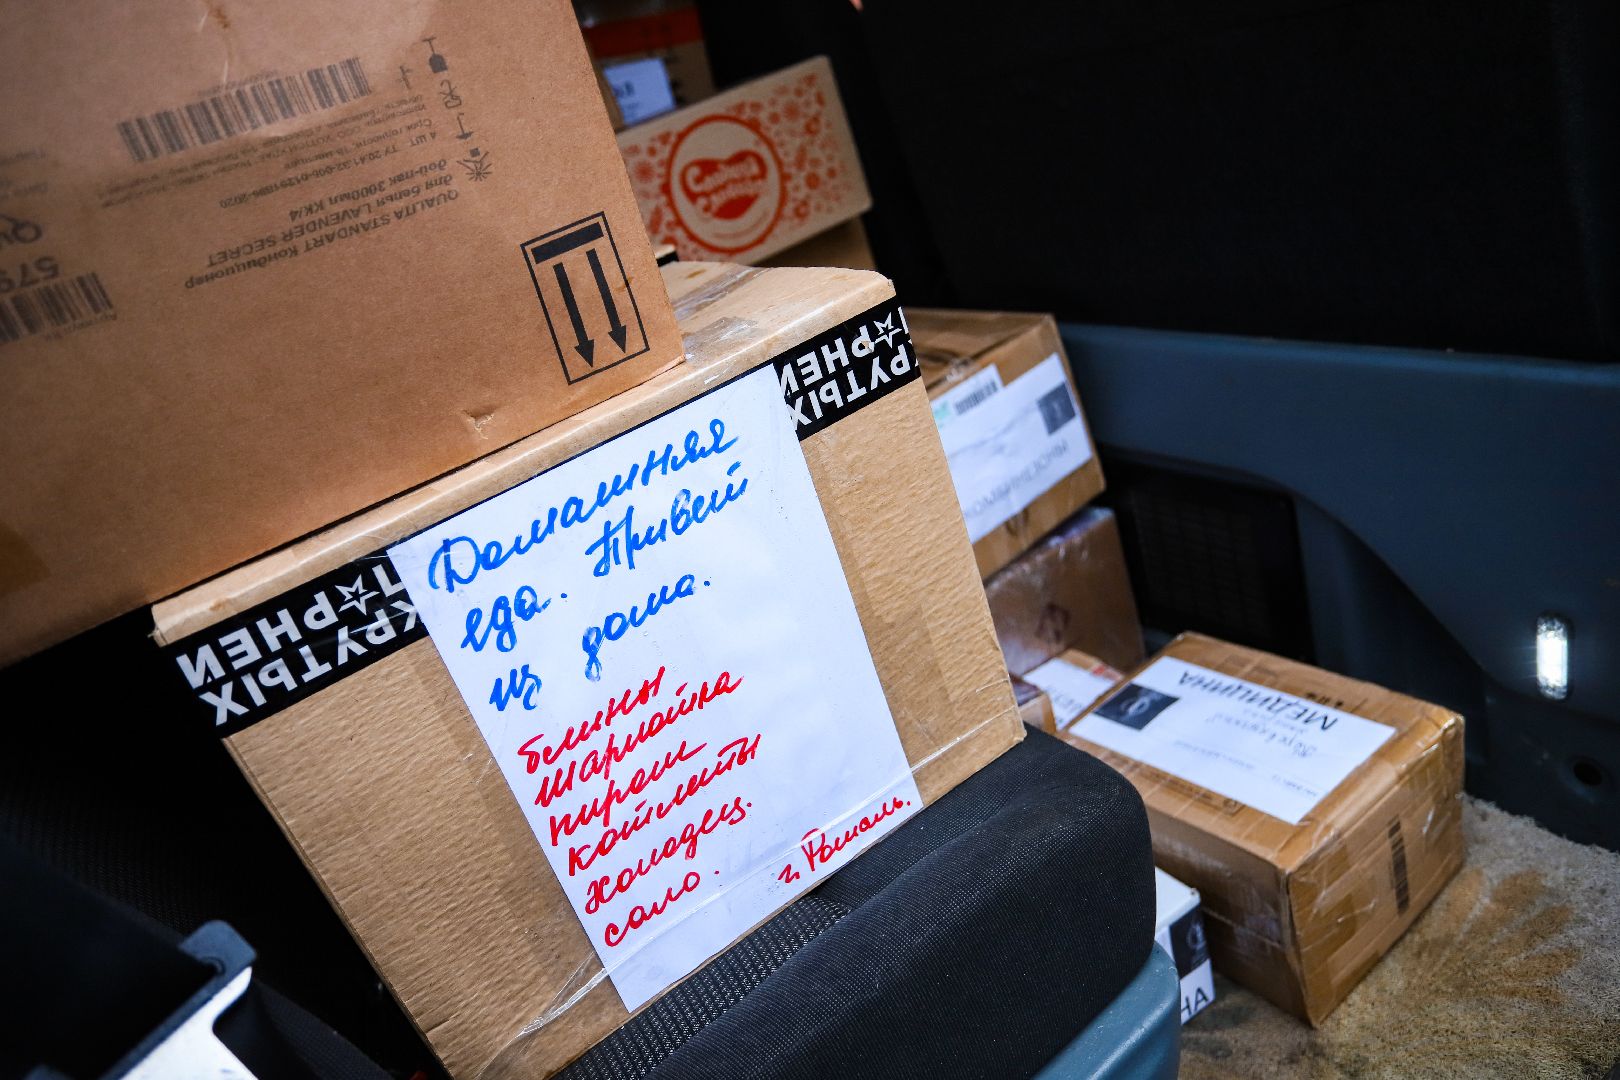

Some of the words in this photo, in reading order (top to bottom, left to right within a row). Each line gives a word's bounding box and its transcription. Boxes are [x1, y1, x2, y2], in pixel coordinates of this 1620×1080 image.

[394, 188, 459, 221] QUALITA
[424, 173, 454, 192] для
[281, 202, 374, 242] LAVENDER
[305, 216, 391, 252] STANDART
[184, 248, 299, 290] Кондиционер
[206, 233, 278, 269] SECRET
[786, 339, 919, 431] РУТЫХ
[428, 418, 739, 594] Домашняя
[585, 461, 748, 577] Привет
[489, 664, 542, 711] из
[582, 574, 711, 682] дома.
[517, 666, 666, 774] блины
[1178, 669, 1340, 731] МЕДИЦИНА
